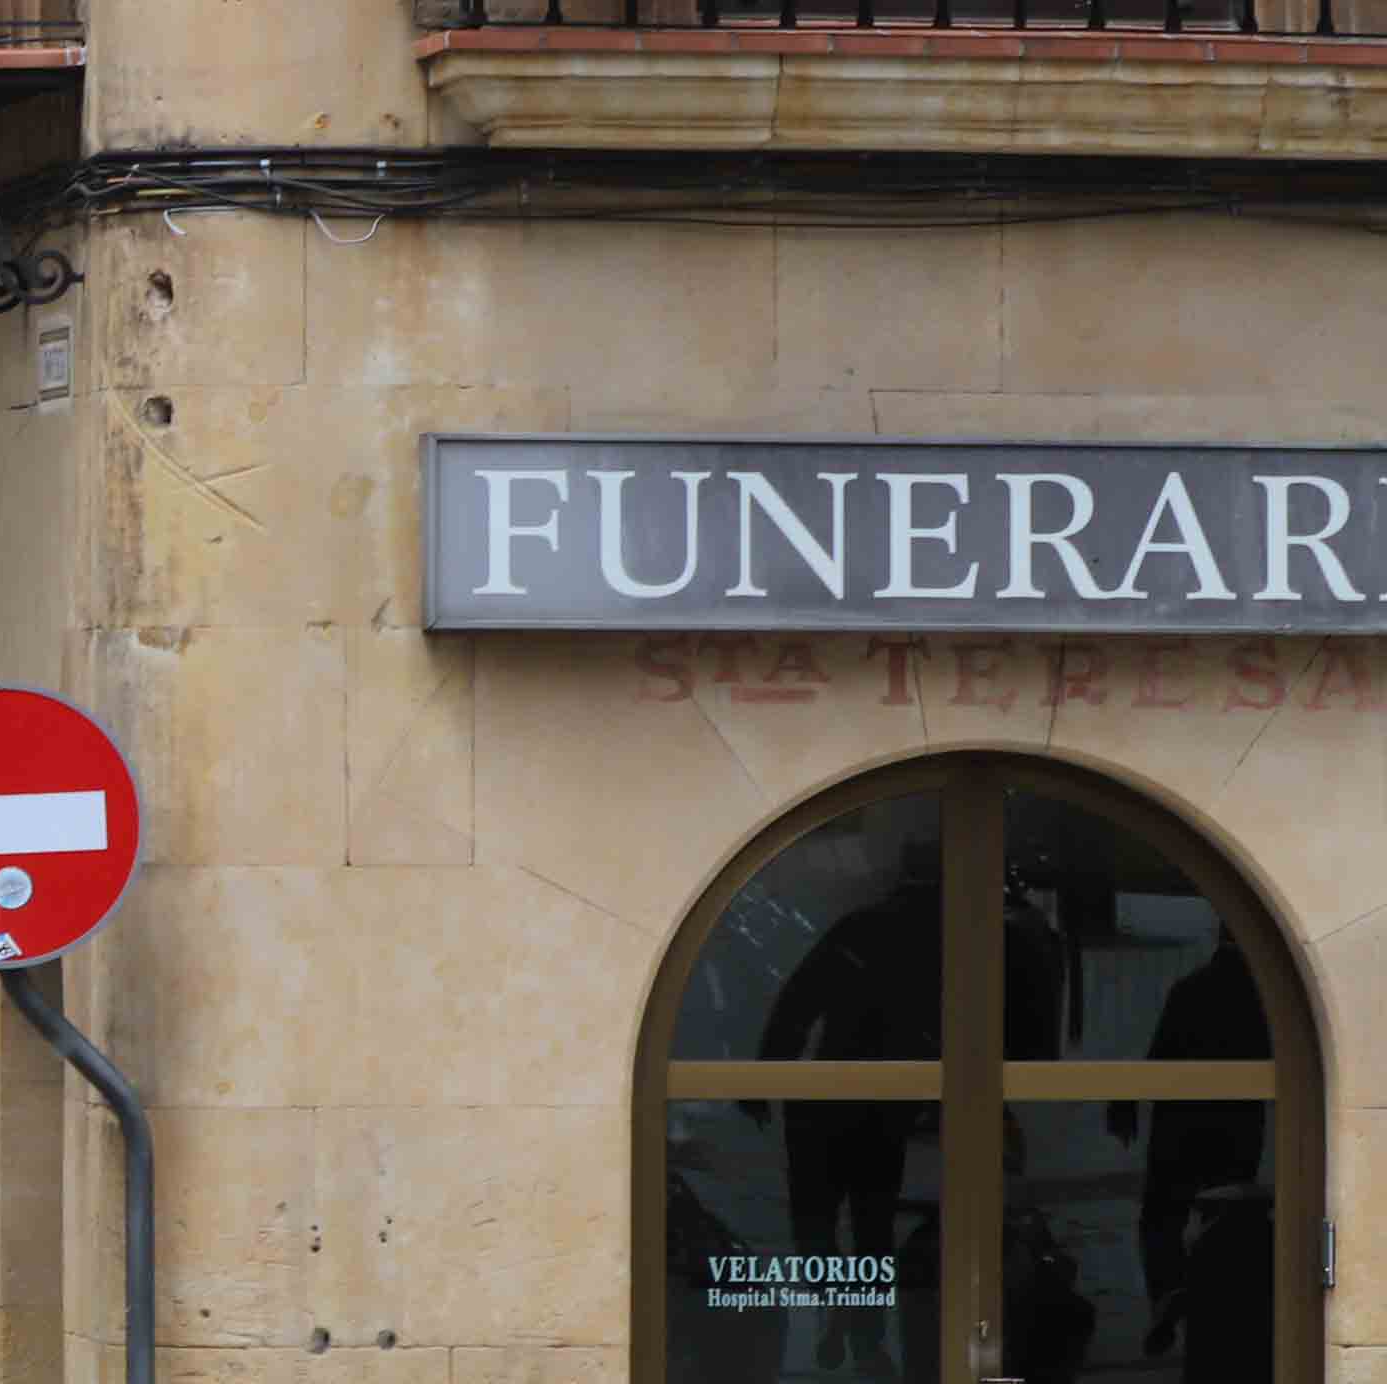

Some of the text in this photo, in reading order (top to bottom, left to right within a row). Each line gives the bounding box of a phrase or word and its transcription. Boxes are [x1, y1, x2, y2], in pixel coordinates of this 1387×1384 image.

[471, 468, 1387, 600] FUNERAR
[707, 1256, 896, 1283] VELATORIOS
[707, 1286, 776, 1312] Hospital
